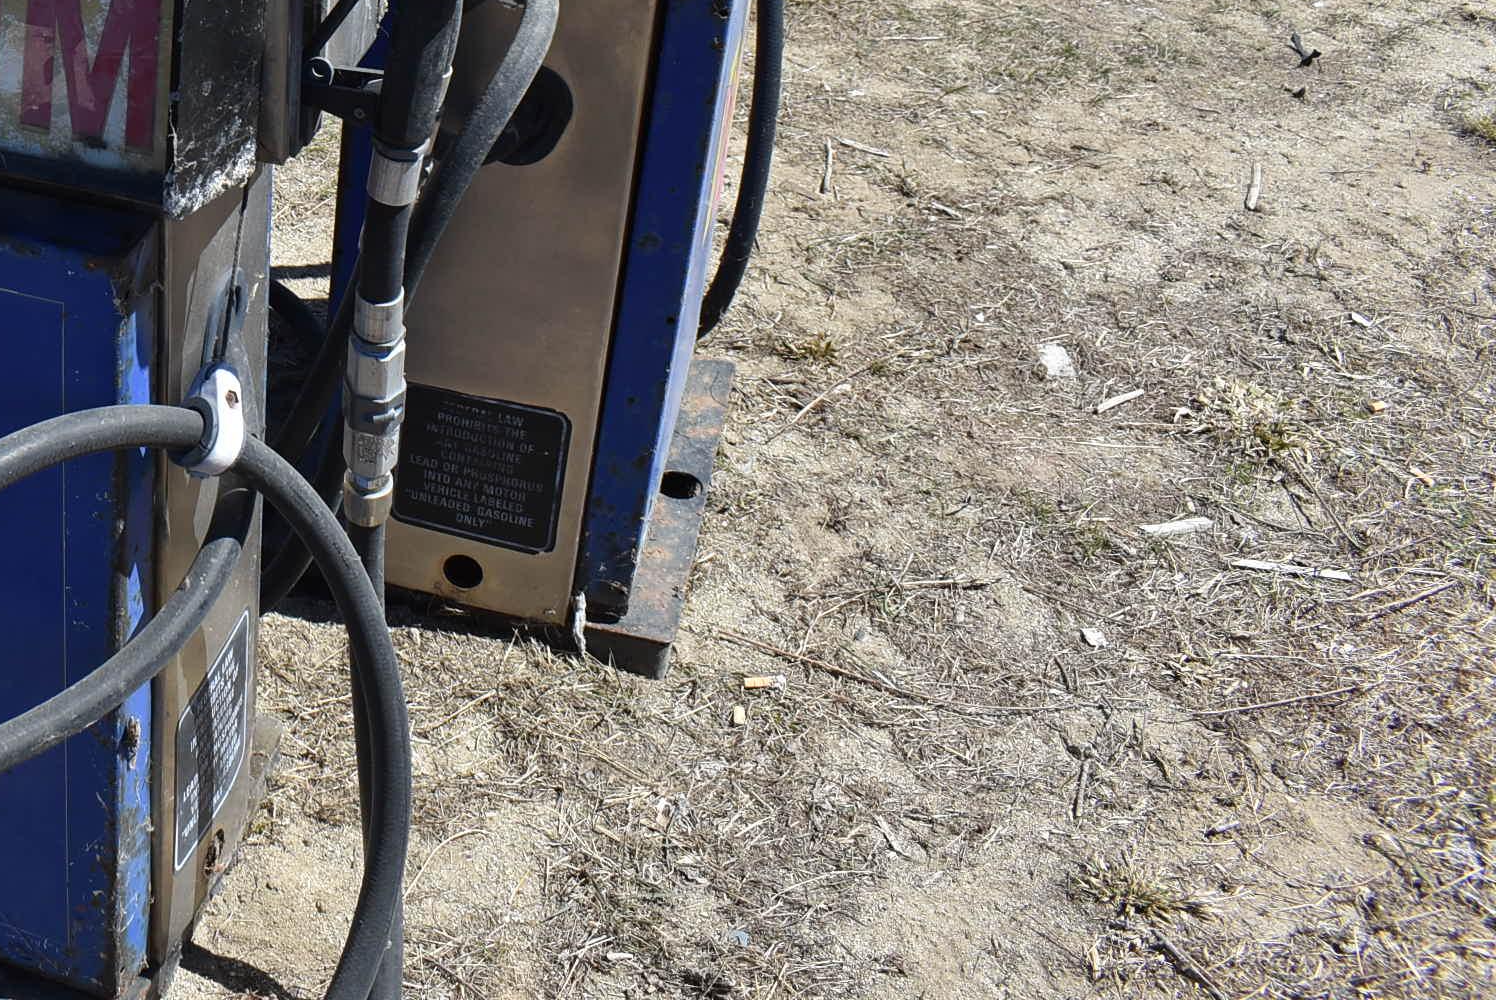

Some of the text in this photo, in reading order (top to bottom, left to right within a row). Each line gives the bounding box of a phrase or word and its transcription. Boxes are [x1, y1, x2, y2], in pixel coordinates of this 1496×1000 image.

[498, 413, 525, 427] LAW
[505, 427, 528, 440] THE
[520, 443, 536, 454] OF
[408, 453, 438, 468] LEAD
[442, 463, 459, 473] OR
[424, 469, 527, 502] INTO ANY MOTOR
[424, 482, 524, 513] VEHICLE LABELED
[477, 506, 536, 528] GASOLINE
